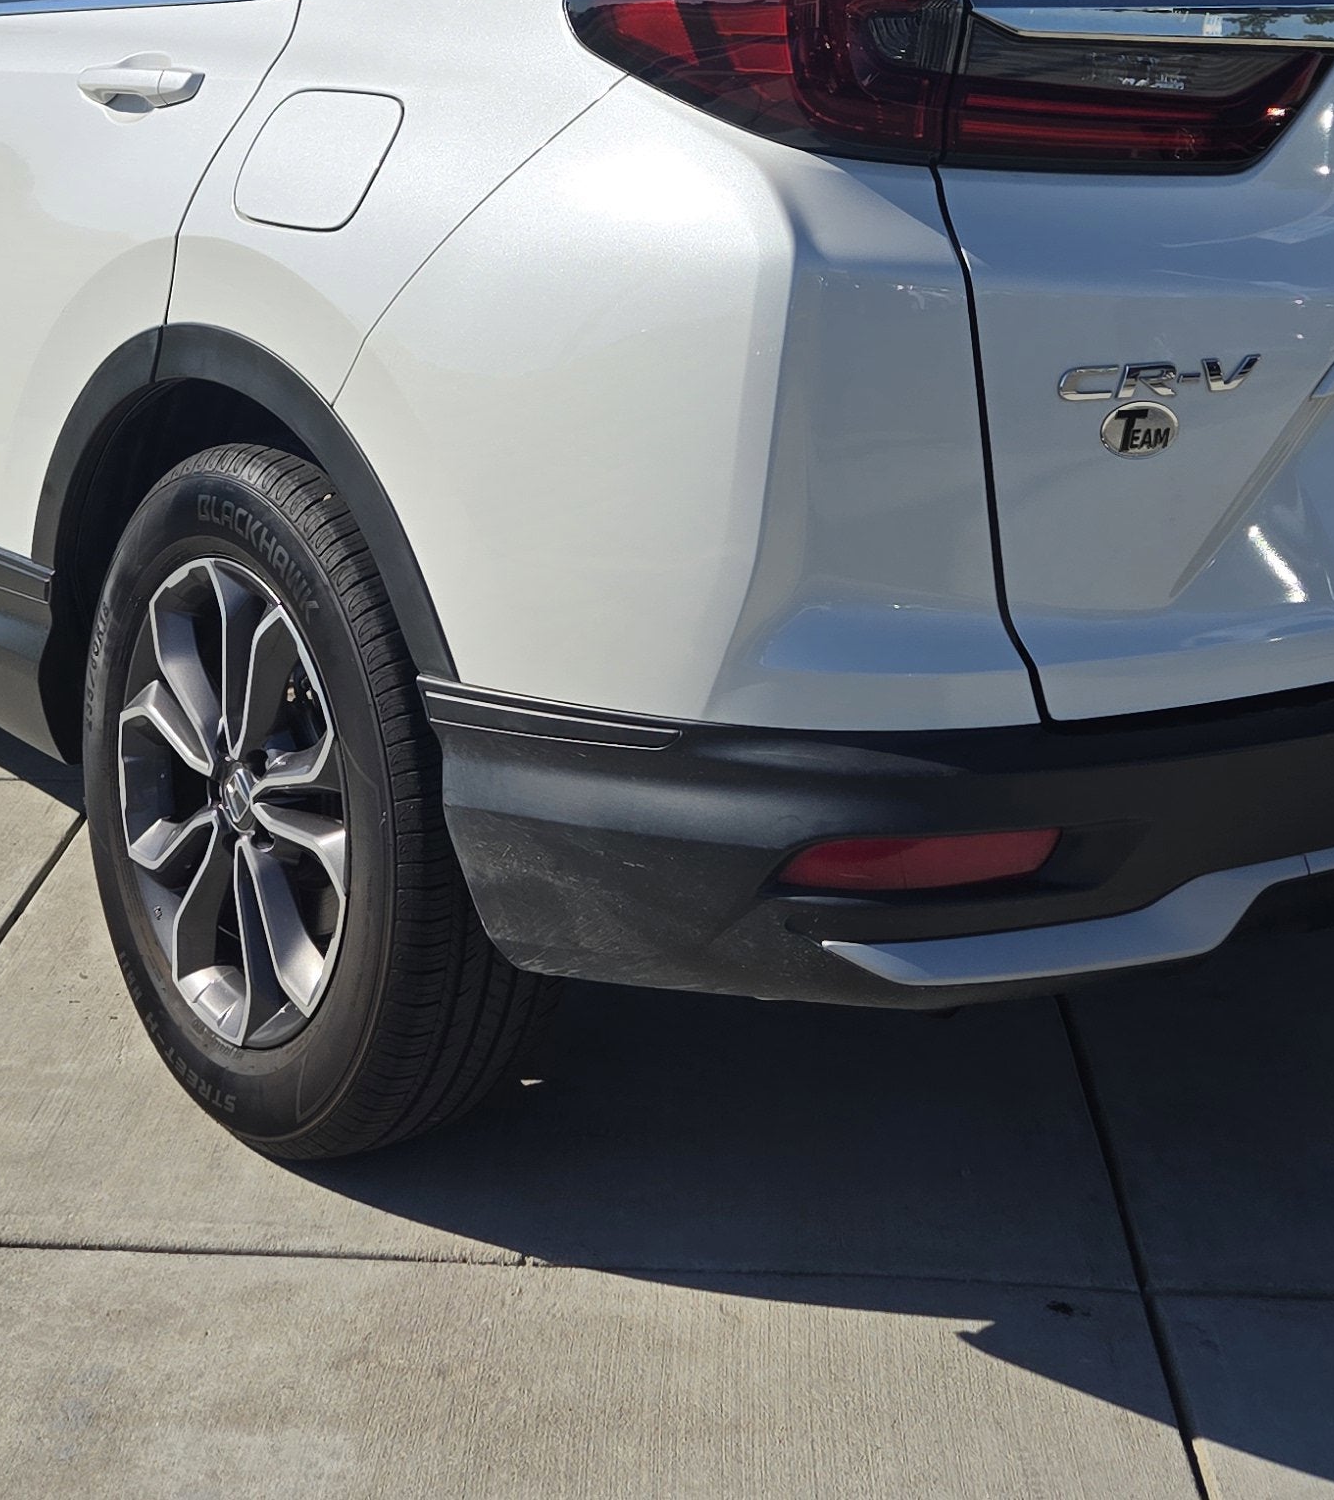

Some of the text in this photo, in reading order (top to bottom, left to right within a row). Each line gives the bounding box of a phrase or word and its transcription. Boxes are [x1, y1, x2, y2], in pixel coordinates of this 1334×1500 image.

[1057, 353, 1262, 401] CR-V
[1114, 408, 1171, 452] TEAM
[196, 493, 320, 625] BLACKHAWK
